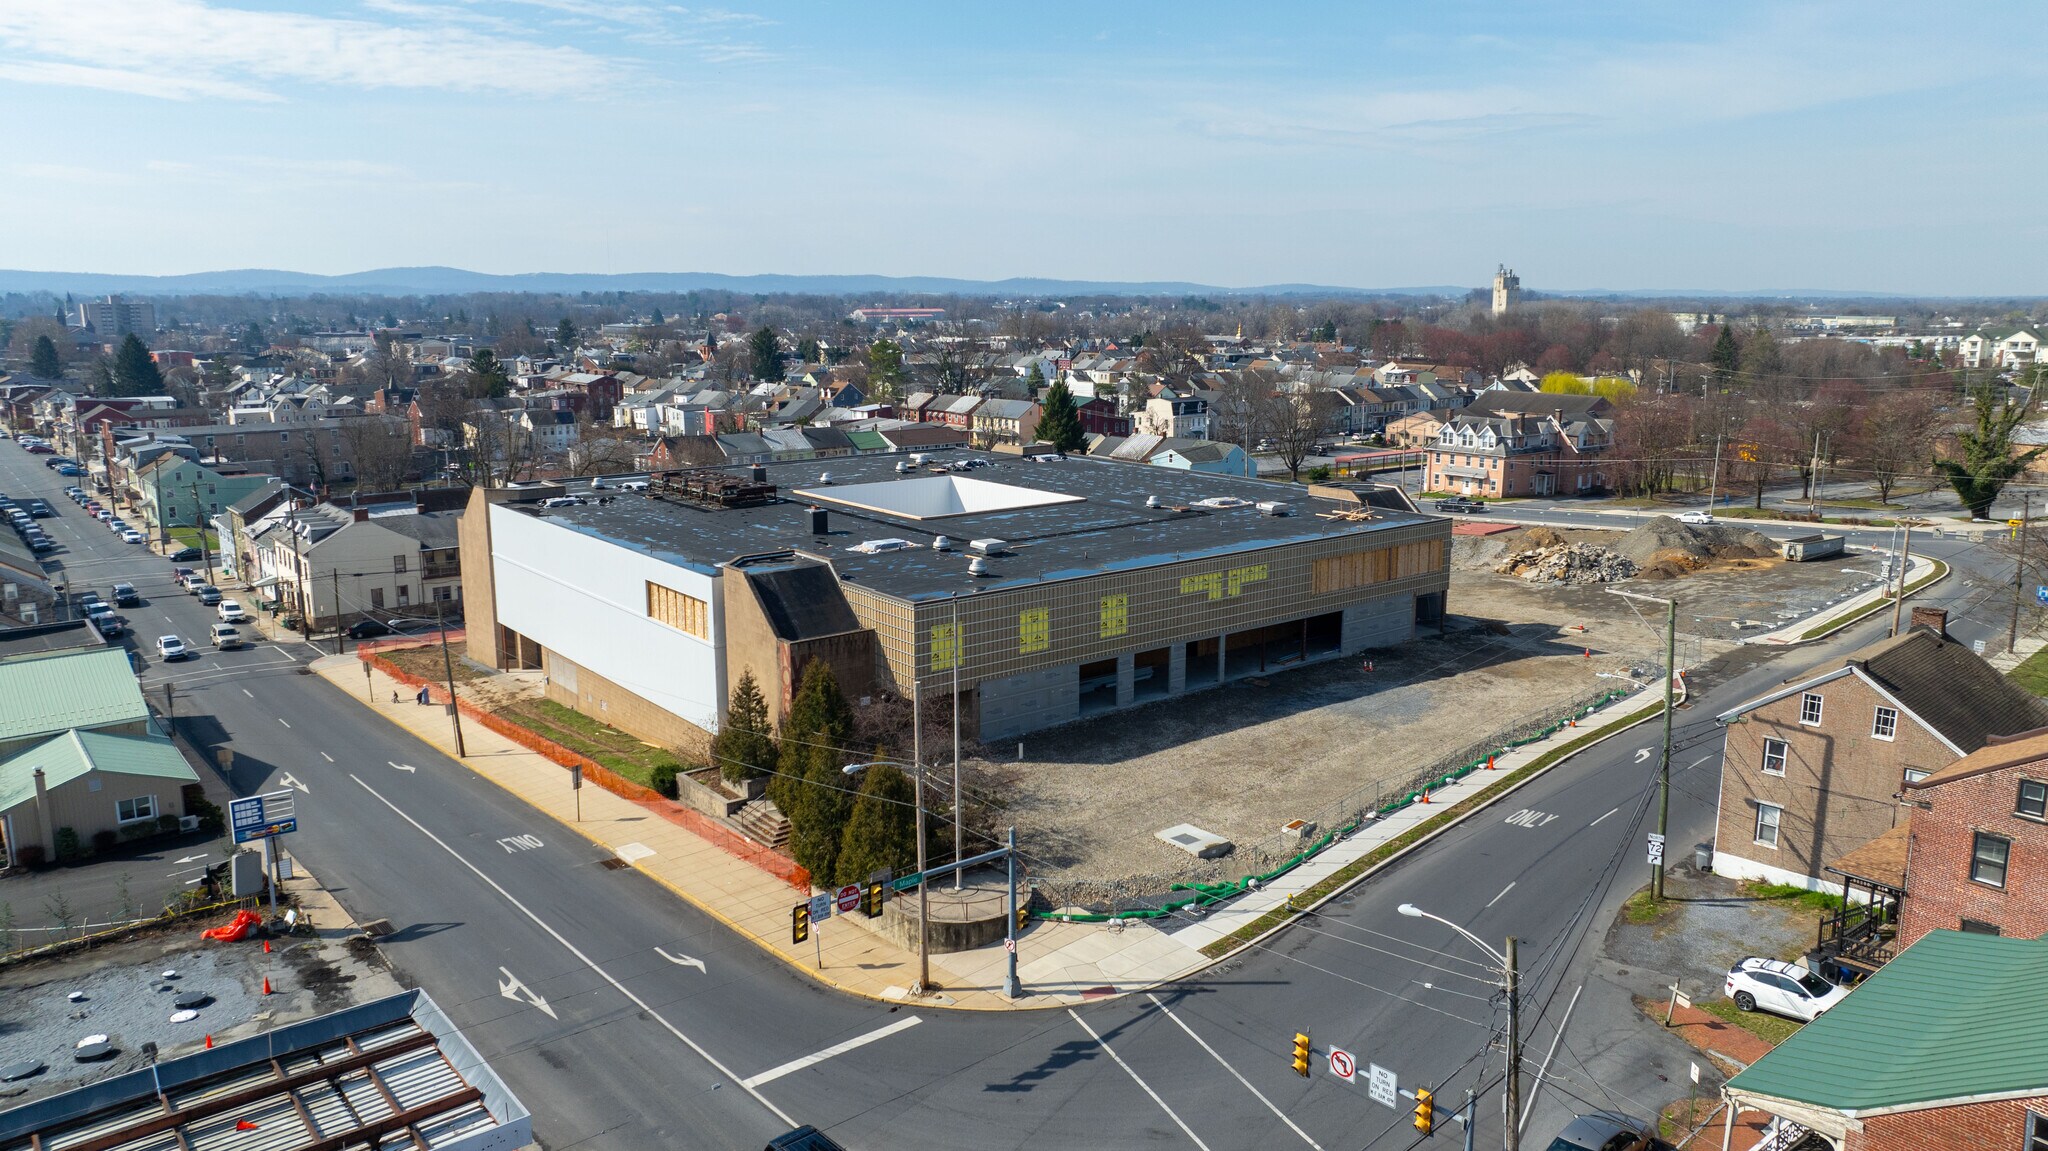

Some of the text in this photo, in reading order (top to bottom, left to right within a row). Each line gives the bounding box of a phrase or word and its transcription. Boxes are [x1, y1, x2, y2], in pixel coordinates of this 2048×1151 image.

[1504, 808, 1559, 828] ONLY
[496, 834, 544, 854] ONLY
[1650, 844, 1662, 852] 72
[899, 876, 918, 888] Maple
[842, 900, 856, 909] ENTER
[1378, 1070, 1388, 1078] NO
[1376, 1076, 1390, 1087] TURN
[1382, 1087, 1394, 1096] RED
